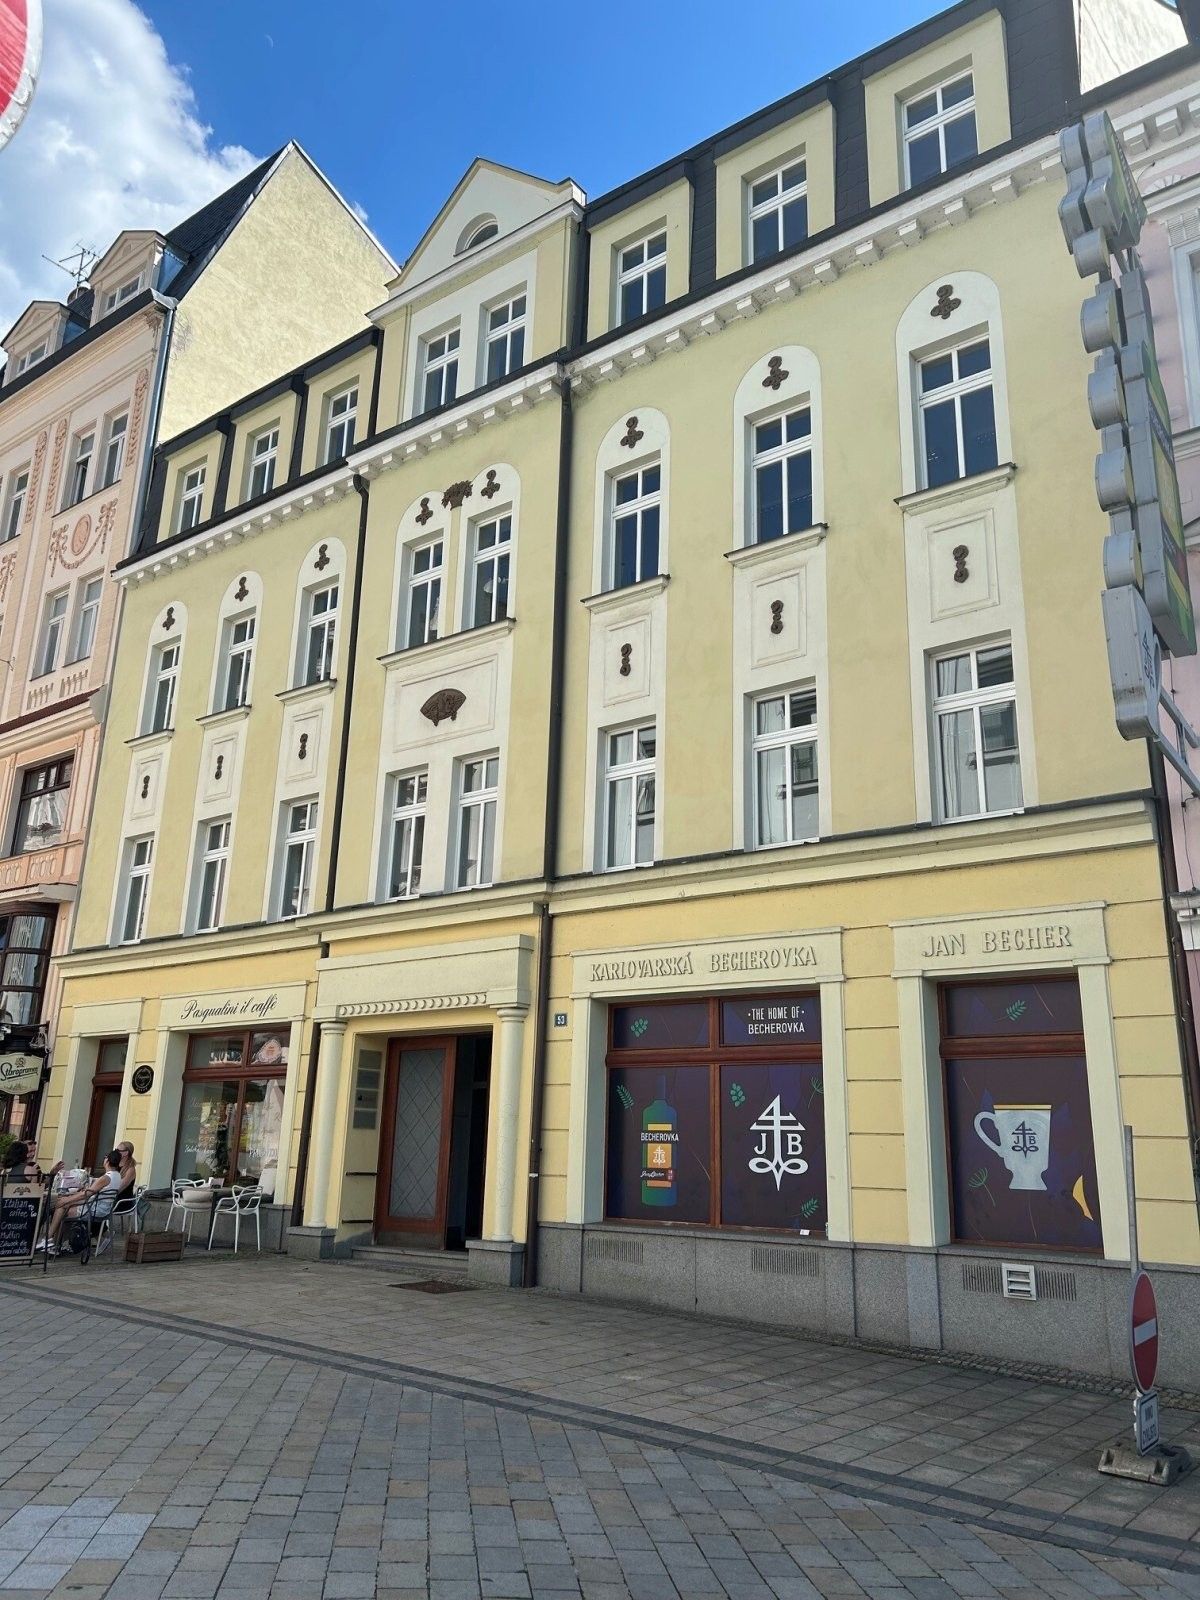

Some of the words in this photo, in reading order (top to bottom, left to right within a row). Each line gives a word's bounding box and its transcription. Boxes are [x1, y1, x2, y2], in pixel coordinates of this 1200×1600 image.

[922, 933, 966, 958] JAN
[982, 924, 1073, 954] BECHER
[589, 952, 694, 982] KARLOVARSKÁ
[709, 945, 817, 973] BECHEROVKA
[181, 999, 239, 1023] Pasqualini
[240, 996, 254, 1014] il
[752, 1008, 765, 1020] THE
[768, 1006, 788, 1020] HOME
[791, 1006, 800, 1019] OF
[748, 1022, 805, 1035] BECHEROVKA
[640, 1132, 679, 1142] BECHEROVKA
